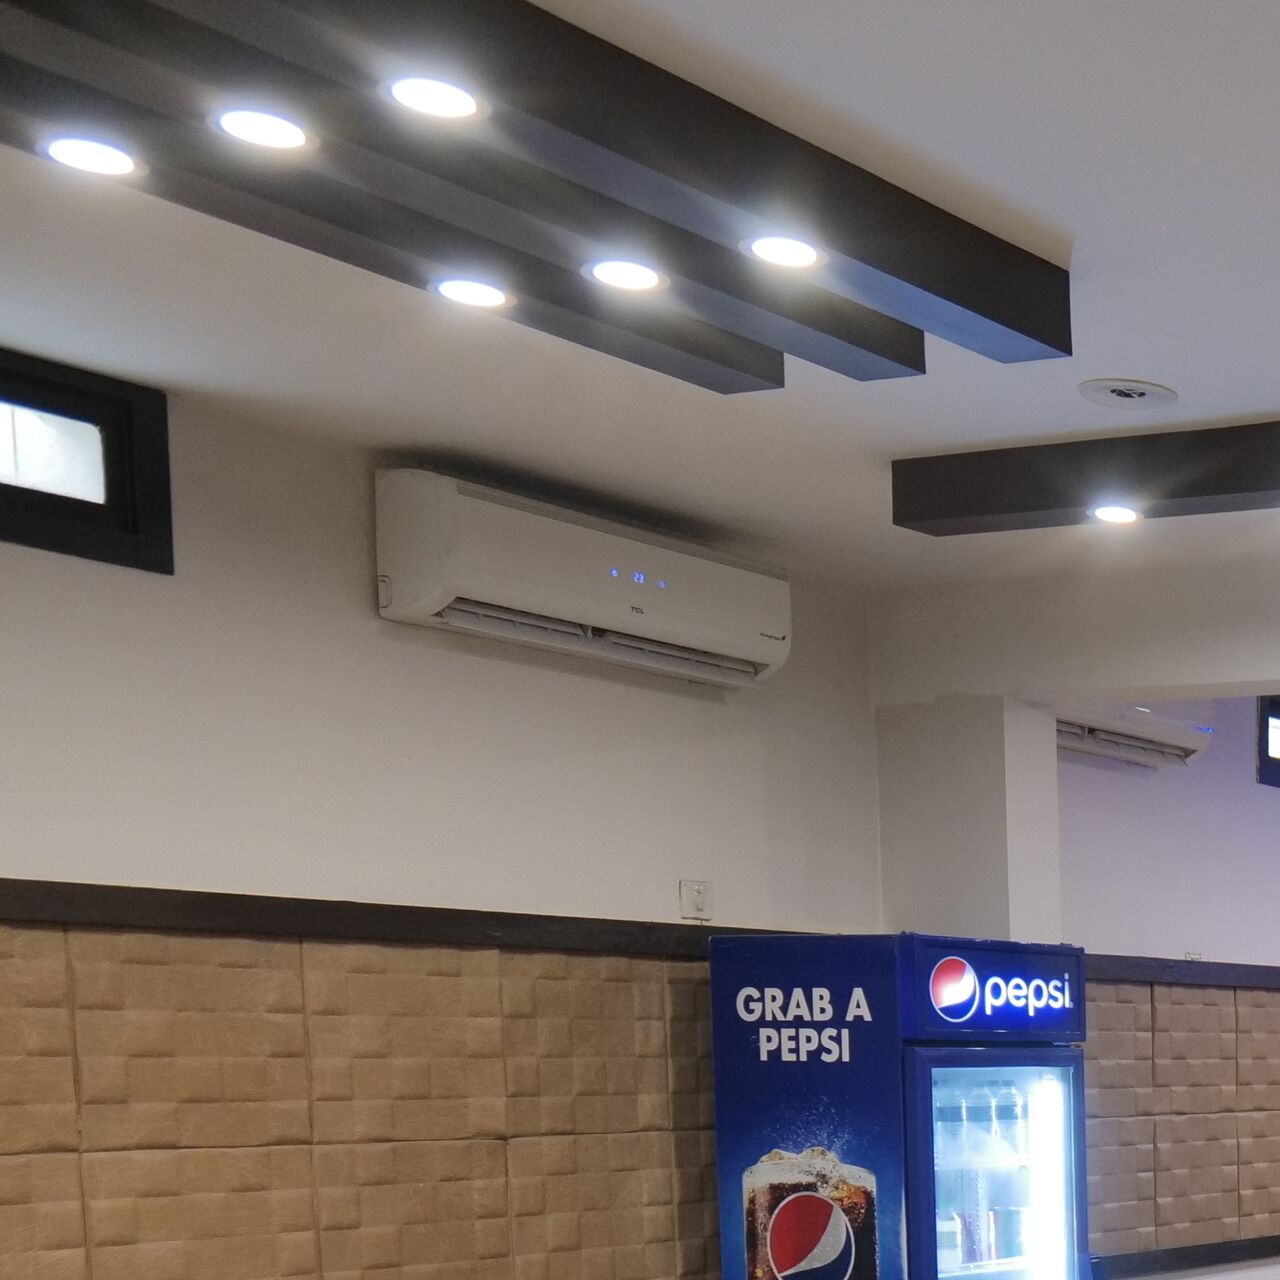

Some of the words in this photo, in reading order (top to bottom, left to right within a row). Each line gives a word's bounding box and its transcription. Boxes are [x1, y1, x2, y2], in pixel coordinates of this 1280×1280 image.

[630, 605, 645, 615] TCL
[736, 986, 833, 1022] GRAB
[845, 987, 872, 1021] A
[985, 972, 1070, 1017] pepsi
[759, 1027, 850, 1063] PEPSI
